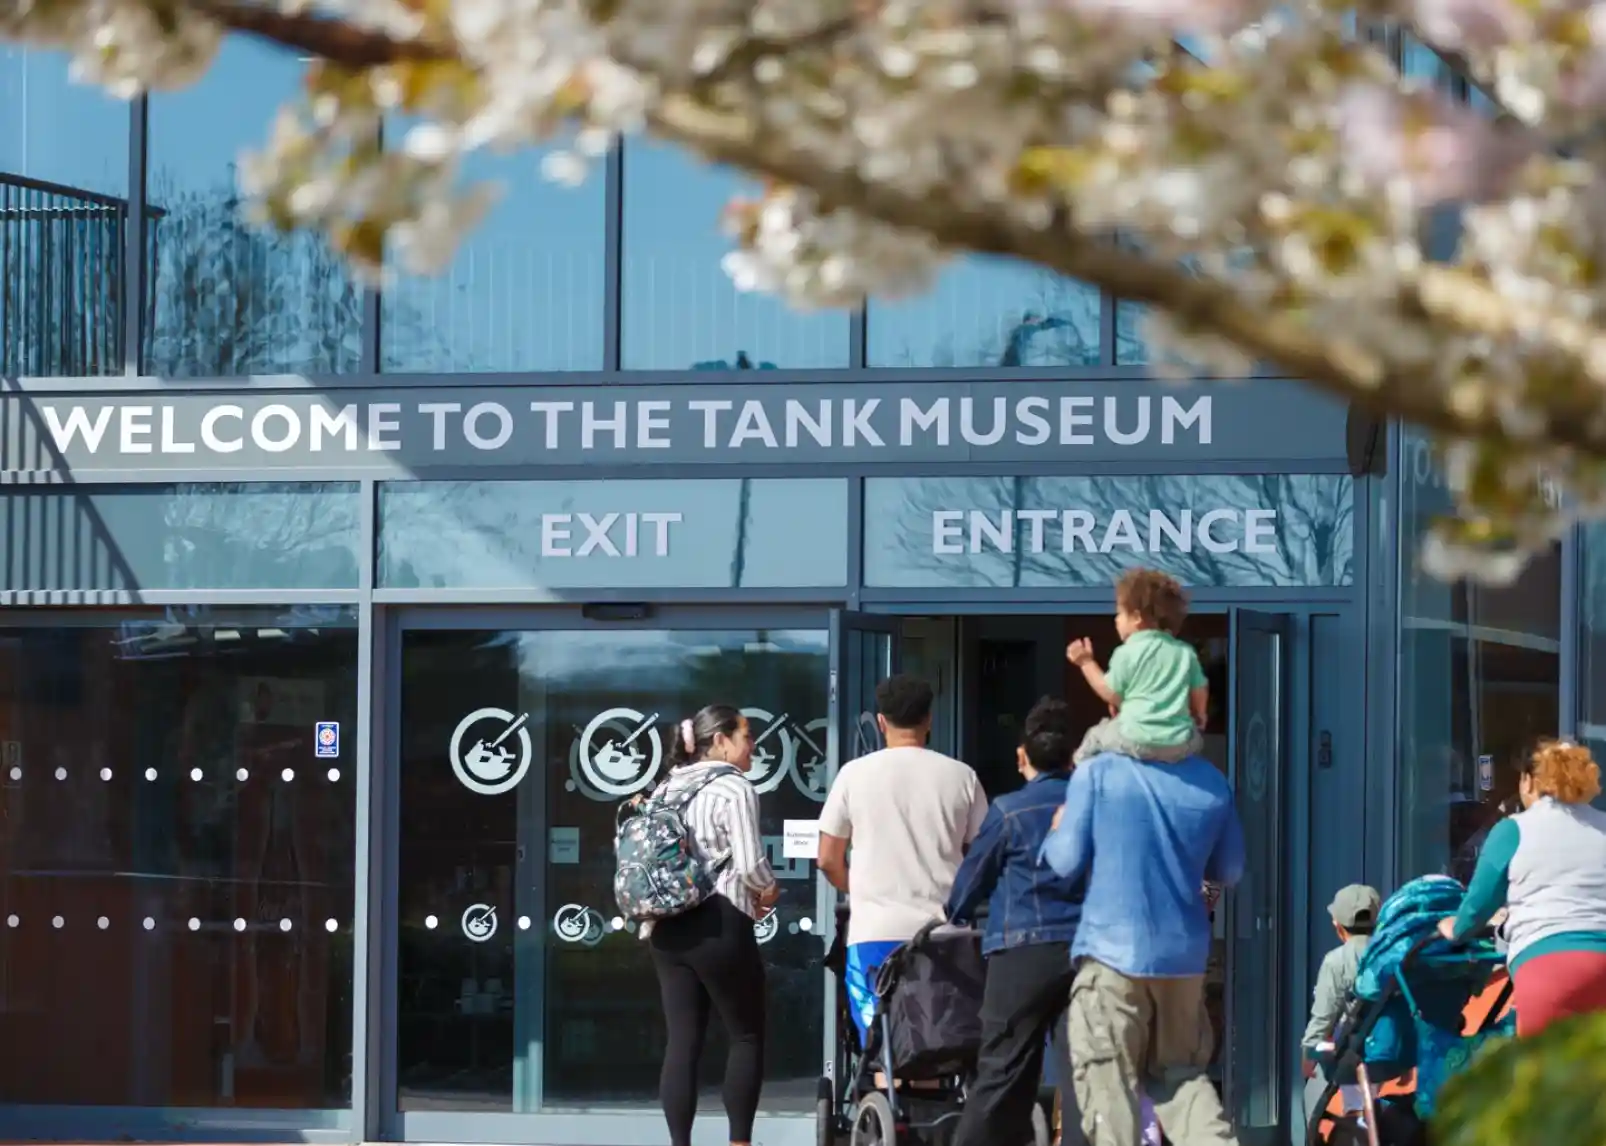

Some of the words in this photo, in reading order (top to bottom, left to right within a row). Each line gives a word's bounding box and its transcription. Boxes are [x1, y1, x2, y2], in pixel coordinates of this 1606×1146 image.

[41, 403, 401, 454] WELCOME
[418, 401, 514, 450] TO
[530, 400, 671, 449] THE
[688, 398, 886, 448] TANK
[900, 396, 1213, 446] MUSEUM
[541, 512, 682, 557] EXIT
[933, 509, 1277, 555] ENTRANCE
